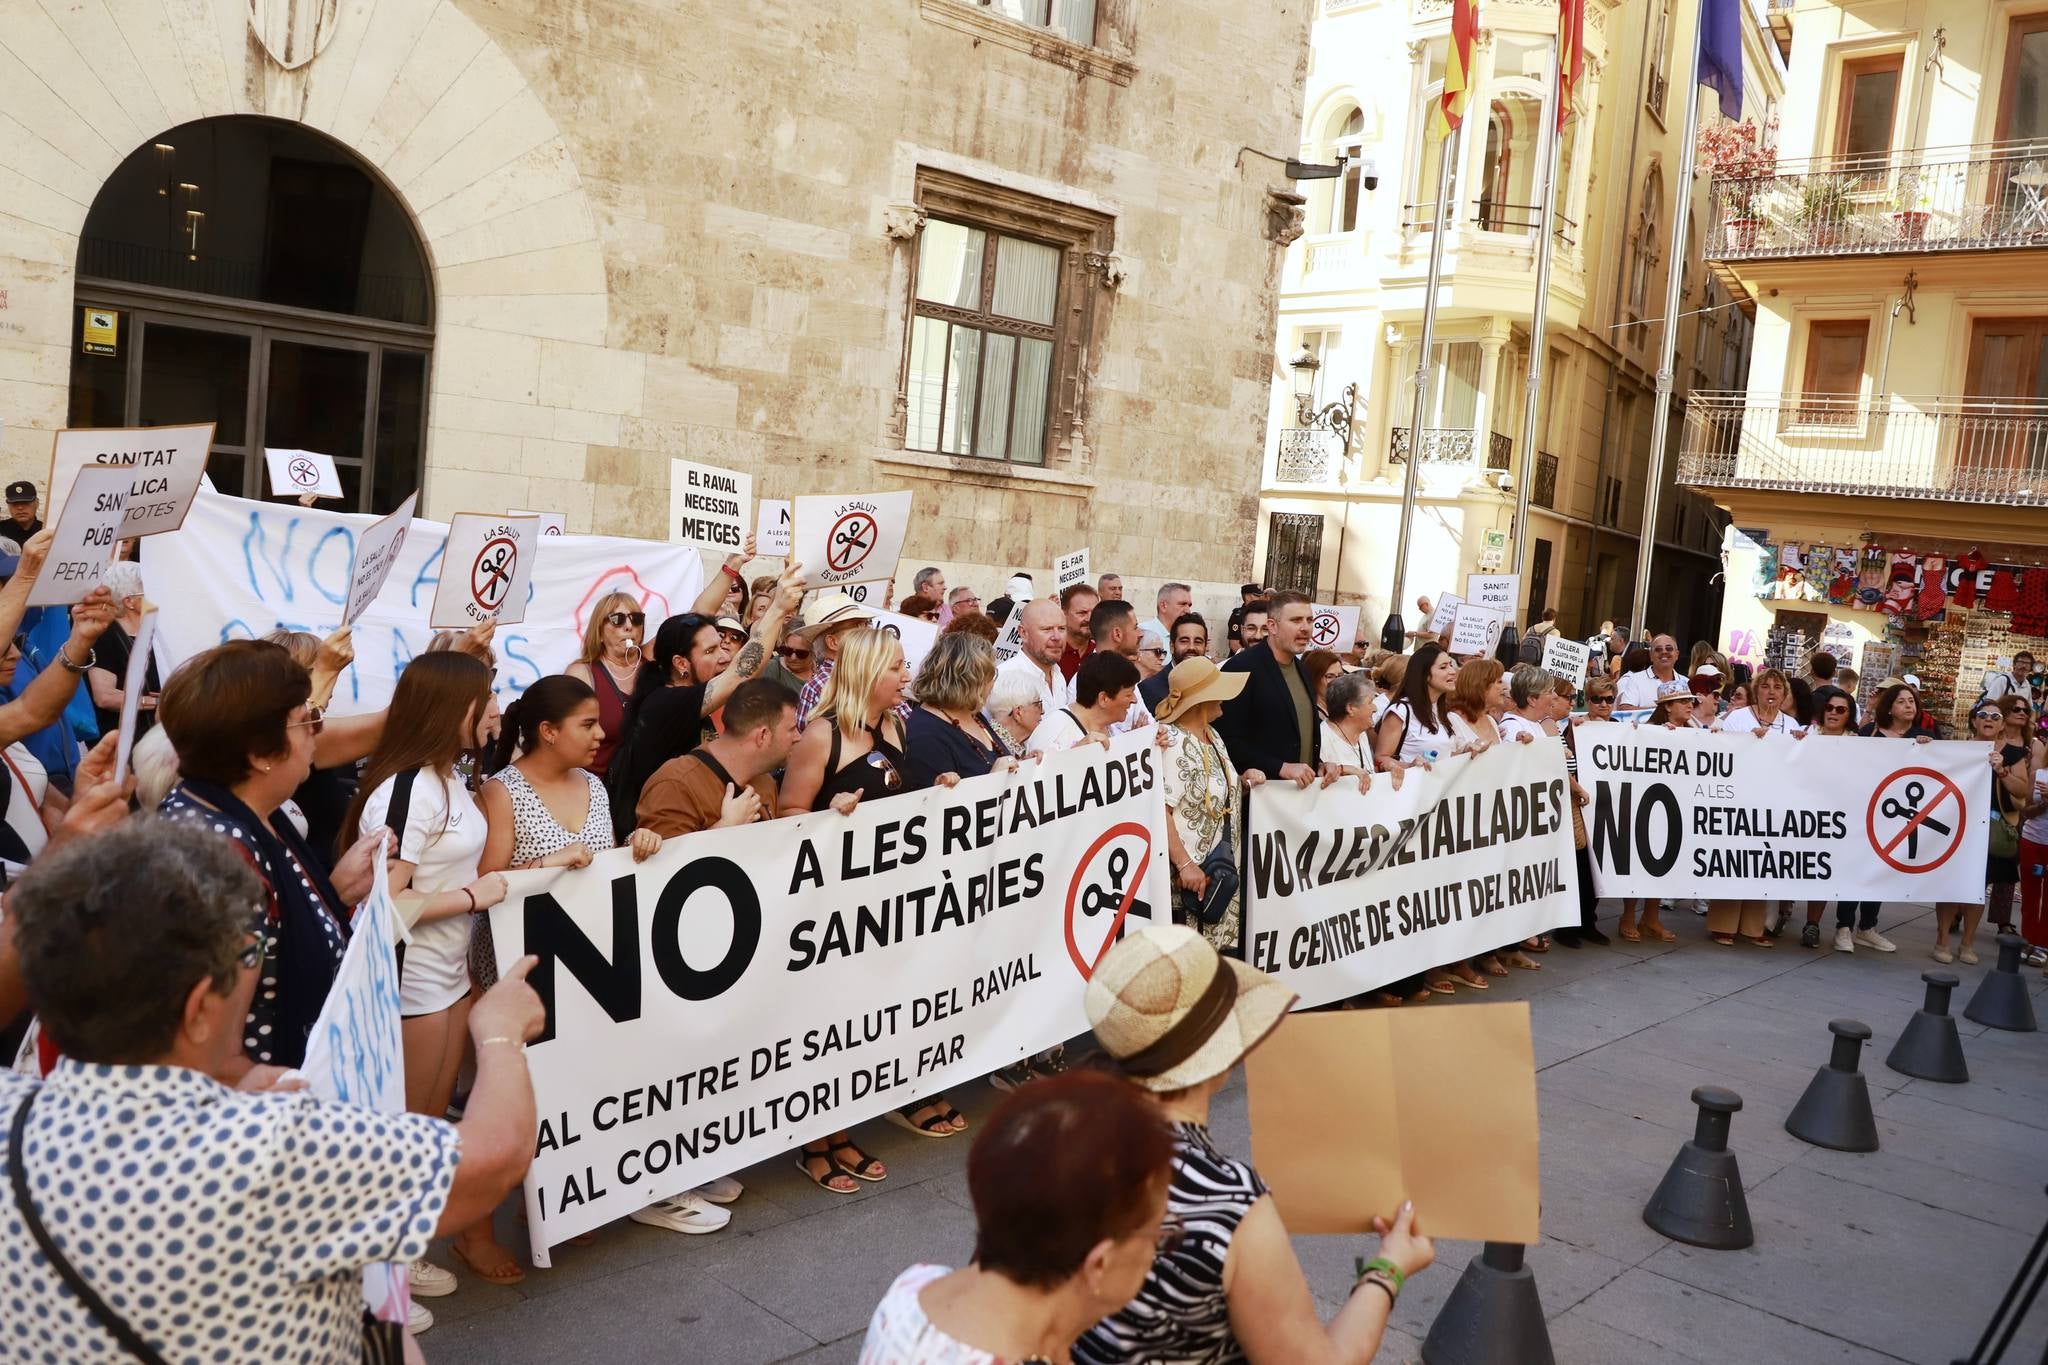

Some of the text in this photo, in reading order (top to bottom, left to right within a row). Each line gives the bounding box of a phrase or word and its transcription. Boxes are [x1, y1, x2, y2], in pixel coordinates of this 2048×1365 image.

[96, 449, 177, 467] SANITAT
[130, 478, 168, 497] LICA
[688, 470, 738, 494] EL RAVAL
[123, 501, 176, 523] TOTES
[684, 493, 739, 517] NECESSITA
[780, 508, 790, 524] N
[834, 501, 878, 518] LA SALUT
[483, 526, 520, 541] LA SALUT
[682, 517, 740, 546] METGES
[53, 561, 99, 581] PER A
[821, 563, 864, 582] ÉS UN DRET
[1061, 555, 1084, 570] EL FAR
[1059, 567, 1085, 584] NECESSITA
[1556, 642, 1580, 654] CULLERA
[1551, 658, 1579, 672] SANITAT
[1592, 744, 1733, 778] CULLERA DIU
[1694, 784, 1735, 799] A LES
[788, 748, 1154, 895] A LES RETALLADES
[1592, 780, 1683, 878] NO
[1693, 805, 1847, 840] RETALLADES
[1295, 830, 1320, 893] A
[1318, 826, 1390, 886] LES
[1378, 779, 1565, 870] RETALLADES
[1693, 842, 1832, 880] SANITÀRIES
[786, 853, 1045, 973] SANITÀRIES
[1253, 857, 1567, 974] EL CENTRE DE SALUT DEL RAVAL
[523, 856, 762, 1048] NO
[534, 952, 1042, 1160] AL CENTRE DE SALUT DEL RAVAL
[537, 1033, 967, 1223] I AL CONSULTORI DEL FAR
